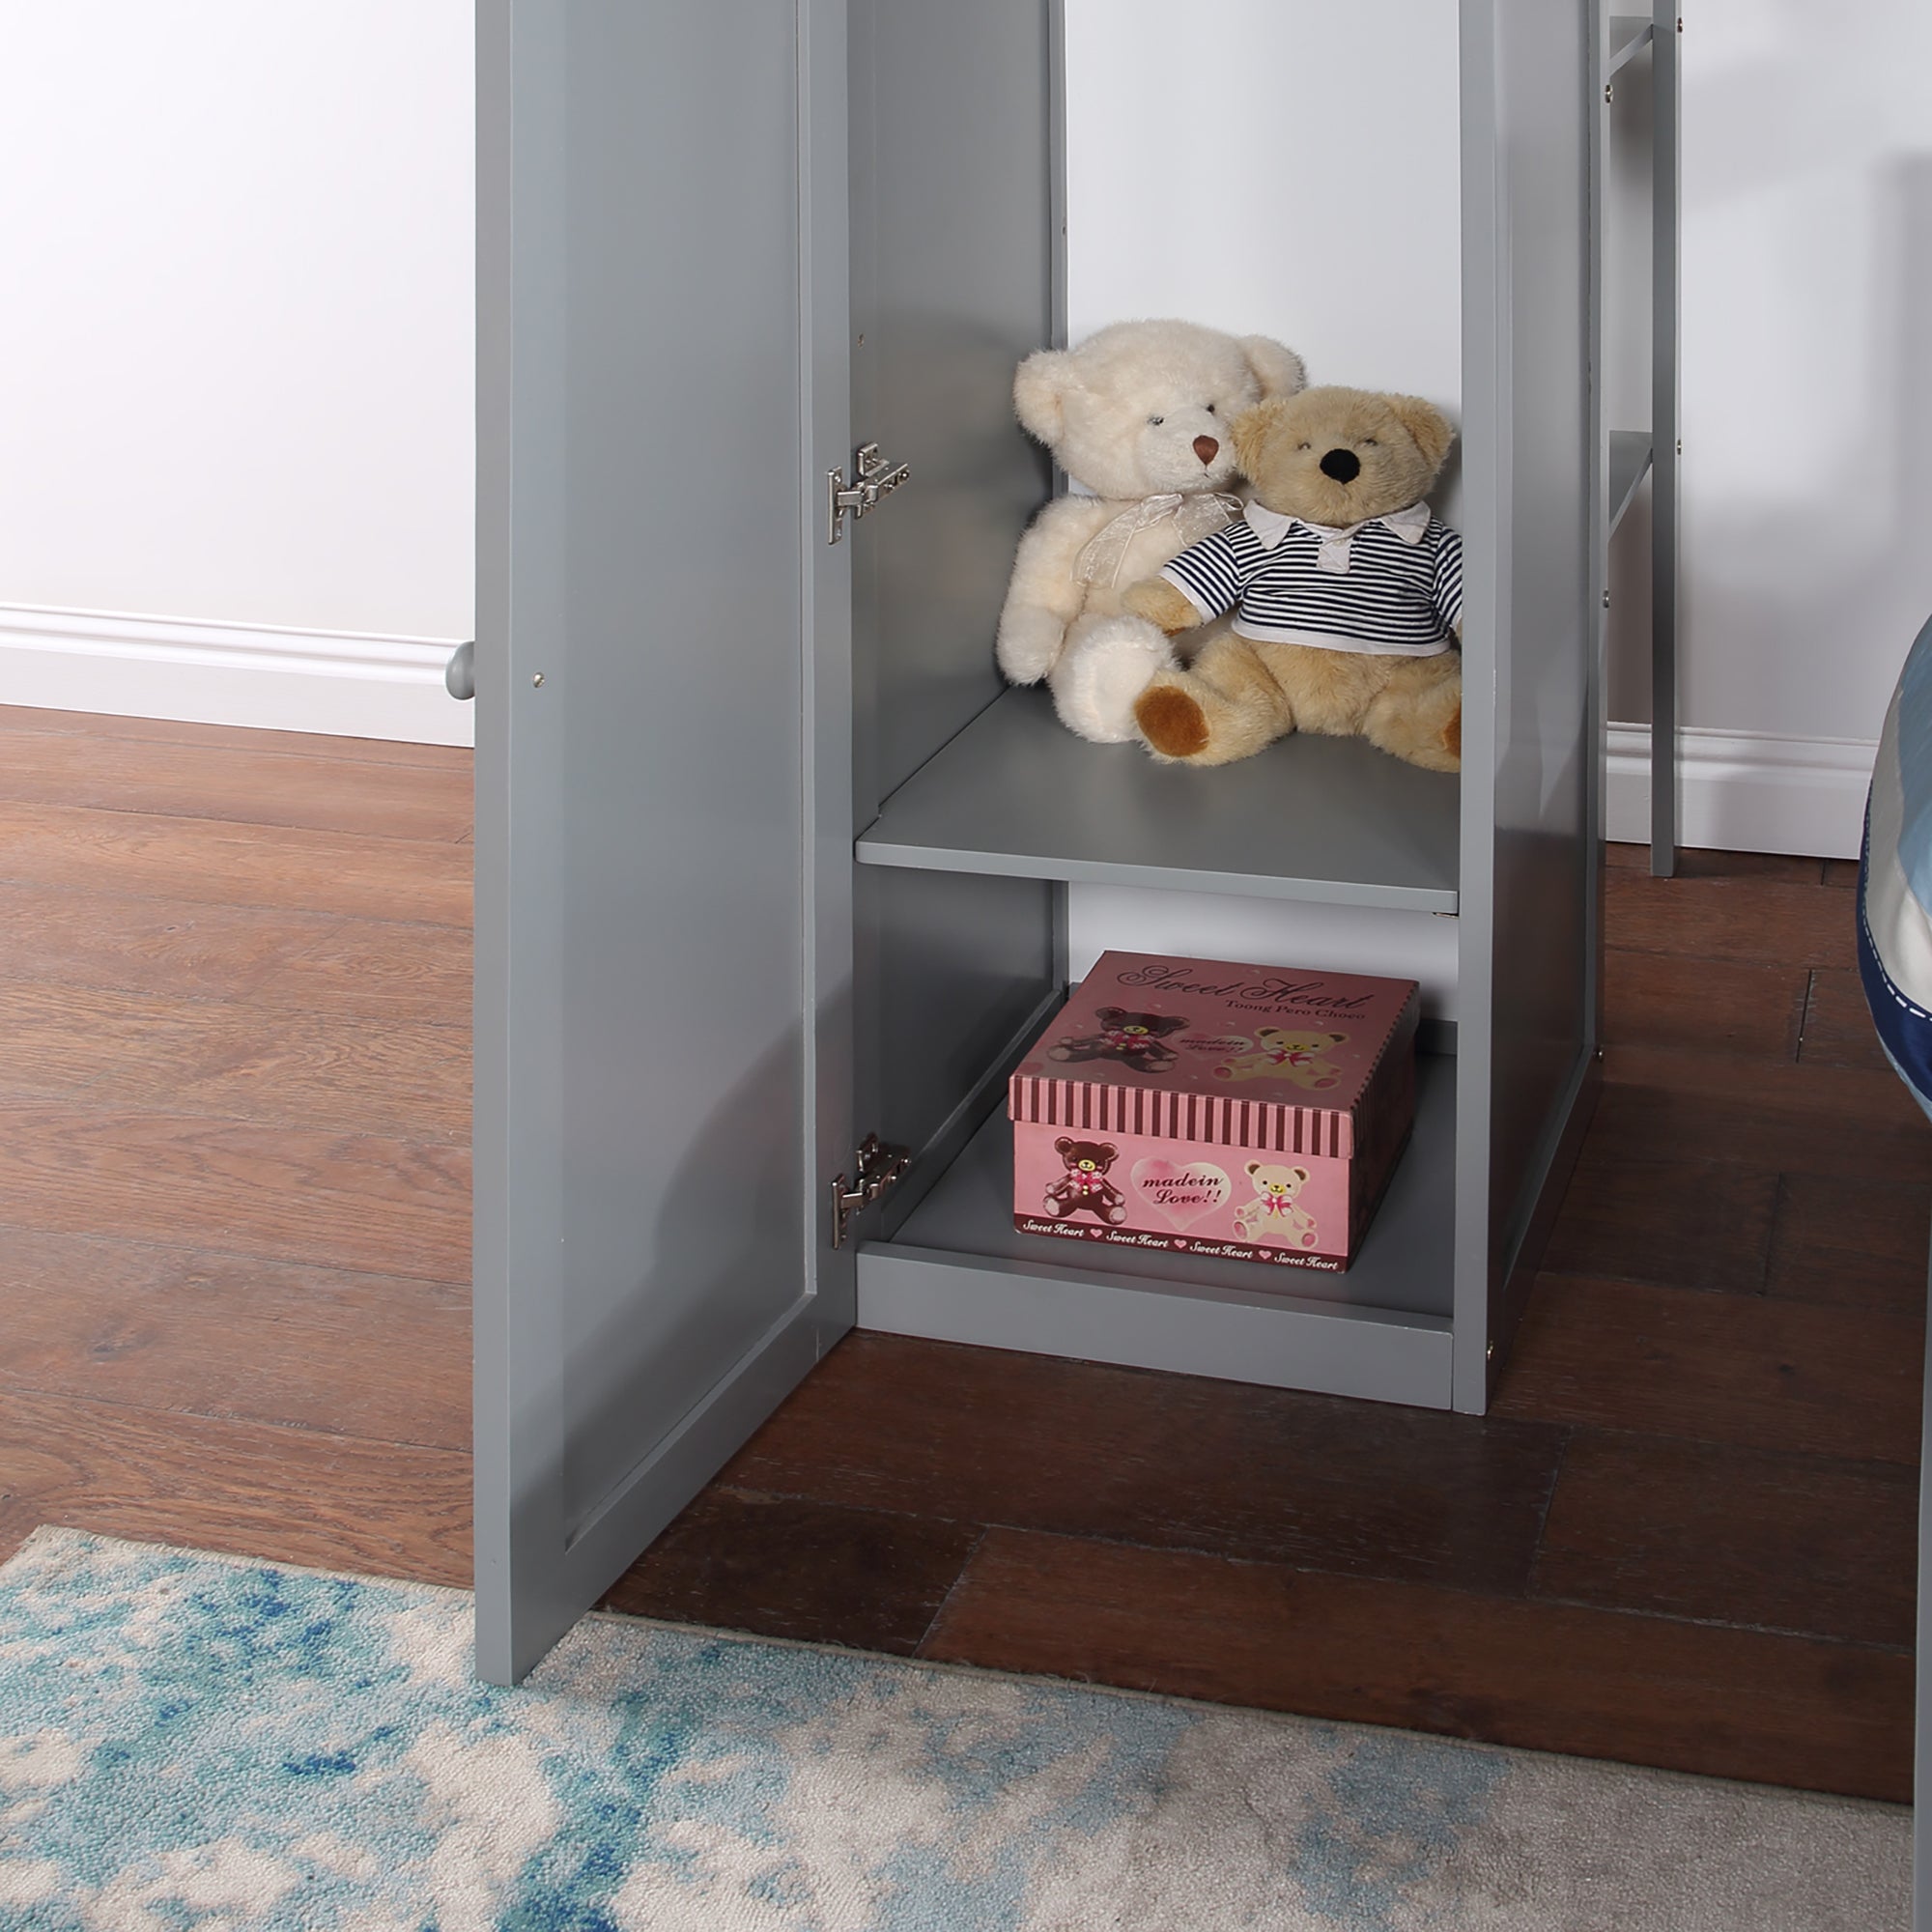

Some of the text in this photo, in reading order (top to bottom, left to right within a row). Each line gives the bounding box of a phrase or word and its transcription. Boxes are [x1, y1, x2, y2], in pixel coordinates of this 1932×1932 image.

[1117, 965, 1375, 1009] Sweet Heart
[1225, 999, 1272, 1013] Toong
[1143, 1173, 1224, 1188] madein
[1152, 1188, 1222, 1205] Love!!
[1023, 1219, 1339, 1270] Sweet Heart Sweet Heart Sweet Heart Sweet Heart
